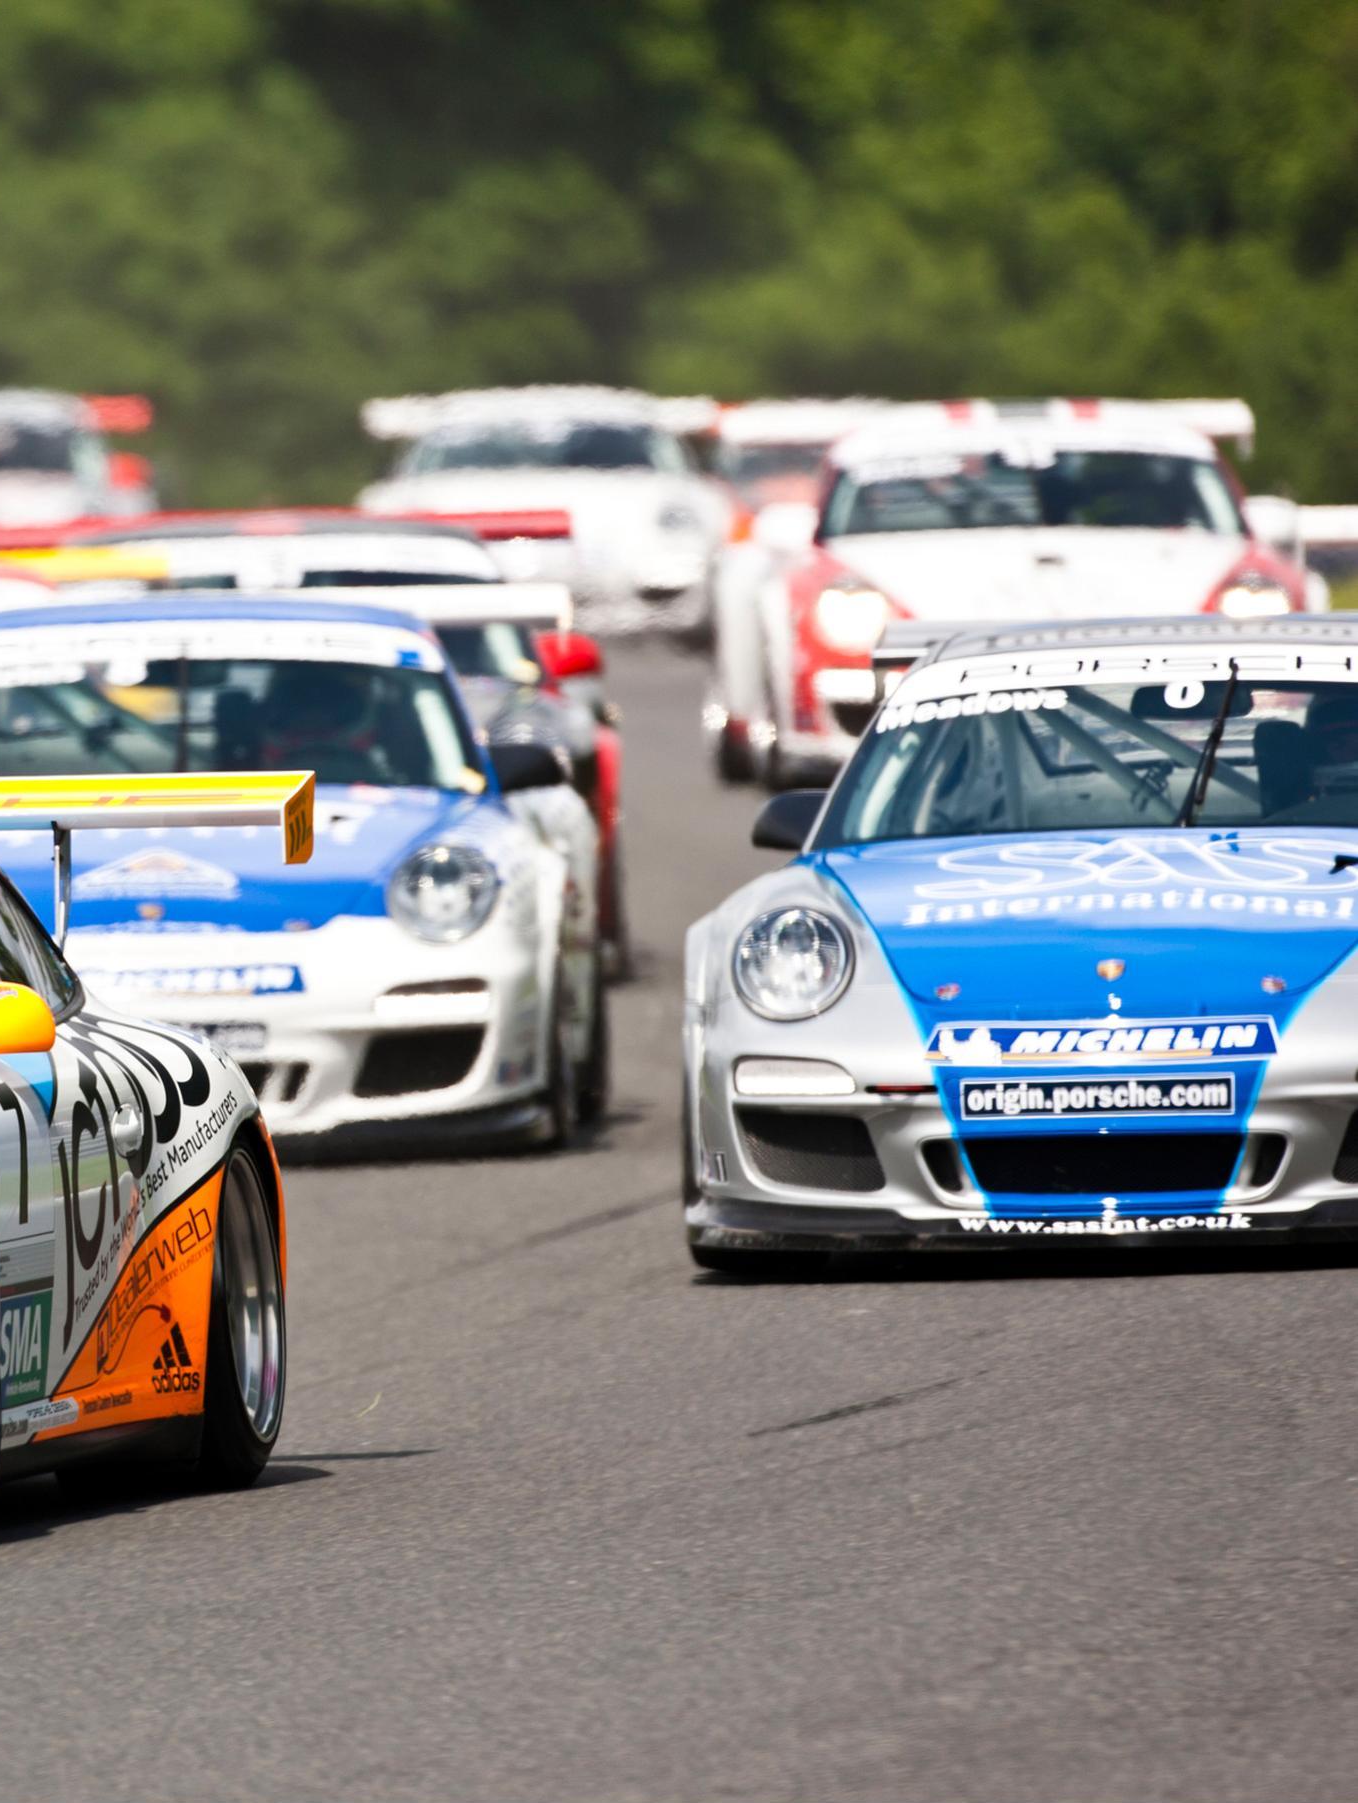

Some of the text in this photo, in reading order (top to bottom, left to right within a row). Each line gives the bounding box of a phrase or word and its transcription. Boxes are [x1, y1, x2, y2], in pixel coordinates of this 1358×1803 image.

[877, 687, 1069, 733] Meadows
[1164, 679, 1205, 709] 0
[903, 887, 1355, 926] International
[1009, 1024, 1259, 1055] MICHELIN
[967, 1080, 1229, 1116] origin.porsche.com
[144, 1157, 169, 1200] Best
[167, 1092, 238, 1174] Manufacturers
[151, 1367, 201, 1394] adidas
